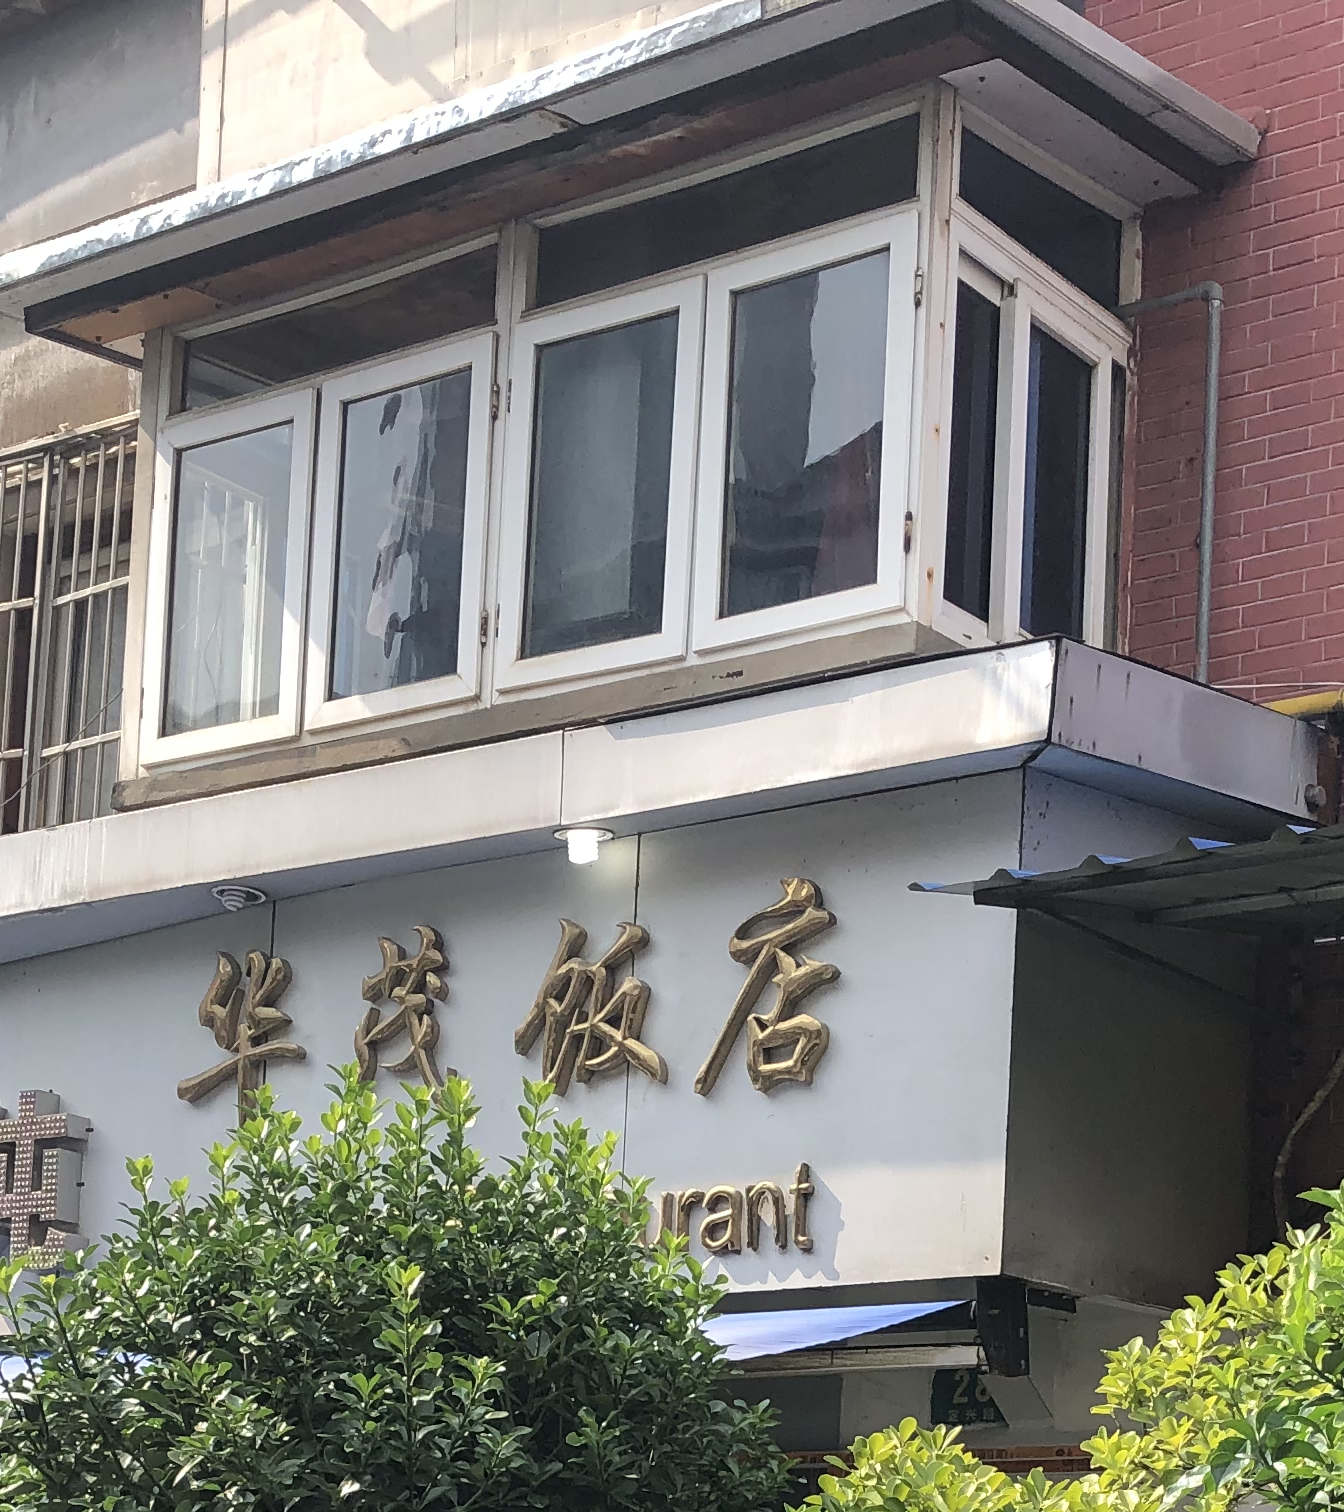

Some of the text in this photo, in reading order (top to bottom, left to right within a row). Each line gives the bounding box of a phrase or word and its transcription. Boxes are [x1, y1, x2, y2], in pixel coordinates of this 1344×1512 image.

[177, 877, 840, 1125] 华茂饭店
[632, 1161, 816, 1255] urant
